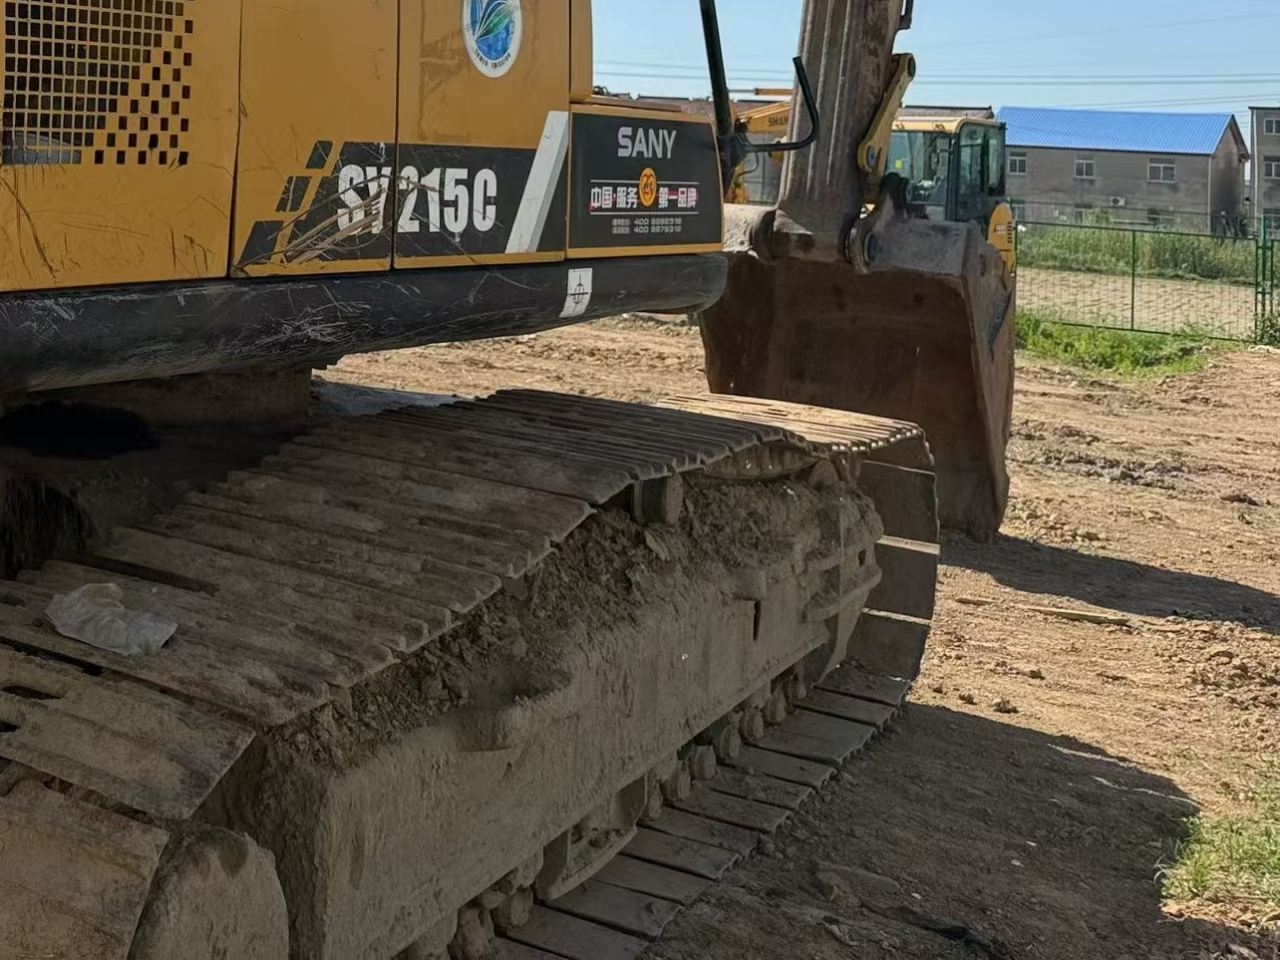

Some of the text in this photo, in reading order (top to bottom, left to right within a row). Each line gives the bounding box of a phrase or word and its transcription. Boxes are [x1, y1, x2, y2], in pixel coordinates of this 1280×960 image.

[617, 126, 677, 159] SANY
[337, 164, 497, 235] SY215C
[658, 187, 697, 208] 第一品牌
